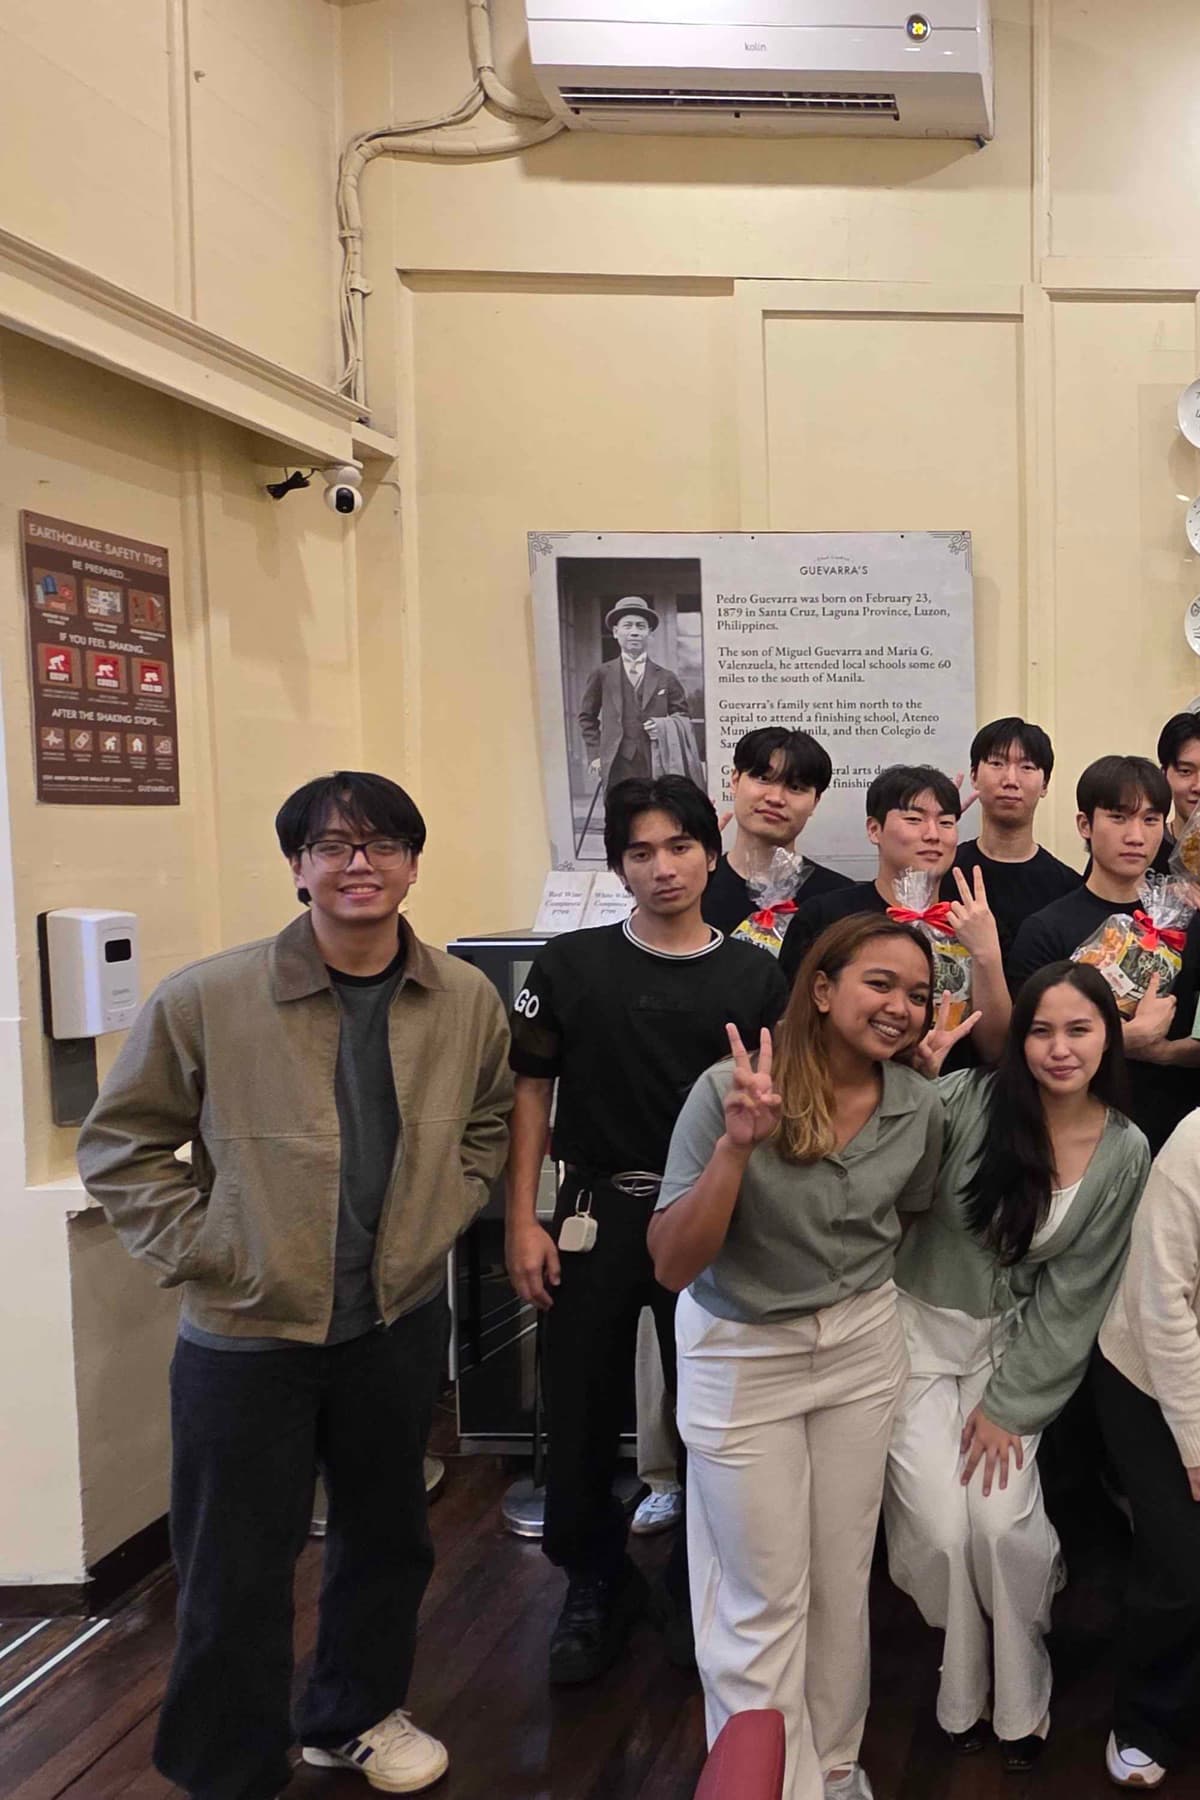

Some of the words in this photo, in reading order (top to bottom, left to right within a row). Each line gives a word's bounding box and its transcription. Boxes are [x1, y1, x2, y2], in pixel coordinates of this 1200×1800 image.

[744, 41, 767, 51] kolin
[29, 523, 102, 553] EARTHQUAKE
[103, 543, 141, 562] SAFETY
[143, 552, 163, 568] TIPS
[72, 560, 82, 570] BE
[800, 566, 868, 576] GUEVARRA'S
[717, 594, 747, 604] Pedro
[750, 594, 798, 604] Guevarra
[800, 596, 820, 604] was
[822, 593, 847, 604] born
[849, 595, 863, 603] on
[866, 593, 912, 606] February
[915, 593, 932, 604] 23,
[718, 607, 743, 617] 1879
[745, 607, 756, 617] in
[758, 608, 787, 617] Santa
[790, 607, 819, 618] Cruz,
[822, 607, 860, 620] Laguna
[862, 607, 912, 617] Province,
[914, 606, 951, 617] Luzon,
[717, 620, 779, 634] Philippines.
[59, 632, 67, 641] IF
[69, 634, 86, 645] YOU
[88, 637, 107, 649] FEEL
[718, 646, 738, 657] The
[741, 648, 759, 657] son
[761, 646, 774, 657] of
[775, 646, 812, 660] Miguel
[814, 646, 862, 656] Guevarra
[864, 646, 884, 656] and
[887, 646, 918, 656] Maria
[920, 646, 933, 656] G.
[718, 659, 777, 671] Valenzuela,
[779, 660, 792, 670] he
[794, 659, 839, 670] attended
[842, 659, 866, 669] local
[869, 659, 906, 669] schools
[908, 661, 936, 669] some
[937, 659, 952, 669] 60
[718, 673, 745, 683] miles
[747, 674, 759, 683] to
[761, 673, 778, 683] the
[780, 672, 810, 683] south
[812, 672, 825, 683] of
[826, 672, 866, 683] Manila.
[719, 699, 774, 709] Guevarra's
[777, 699, 809, 712] family
[812, 701, 833, 709] sent
[836, 699, 857, 709] him
[860, 699, 889, 709] north
[892, 700, 903, 709] to
[905, 699, 923, 709] the
[52, 708, 78, 719] AFTER
[79, 710, 95, 720] THE
[97, 713, 132, 724] SHAKING
[719, 713, 753, 725] capital
[756, 714, 767, 722] to
[770, 713, 803, 722] attend
[806, 714, 812, 722] a
[815, 712, 861, 725] finishing
[863, 712, 899, 723] school,
[902, 712, 940, 723] Ateneo
[833, 726, 852, 735] and
[855, 726, 878, 735] then
[881, 725, 920, 739] Colegio
[923, 726, 936, 735] de
[852, 766, 872, 775] arts
[513, 988, 540, 1019] GO
